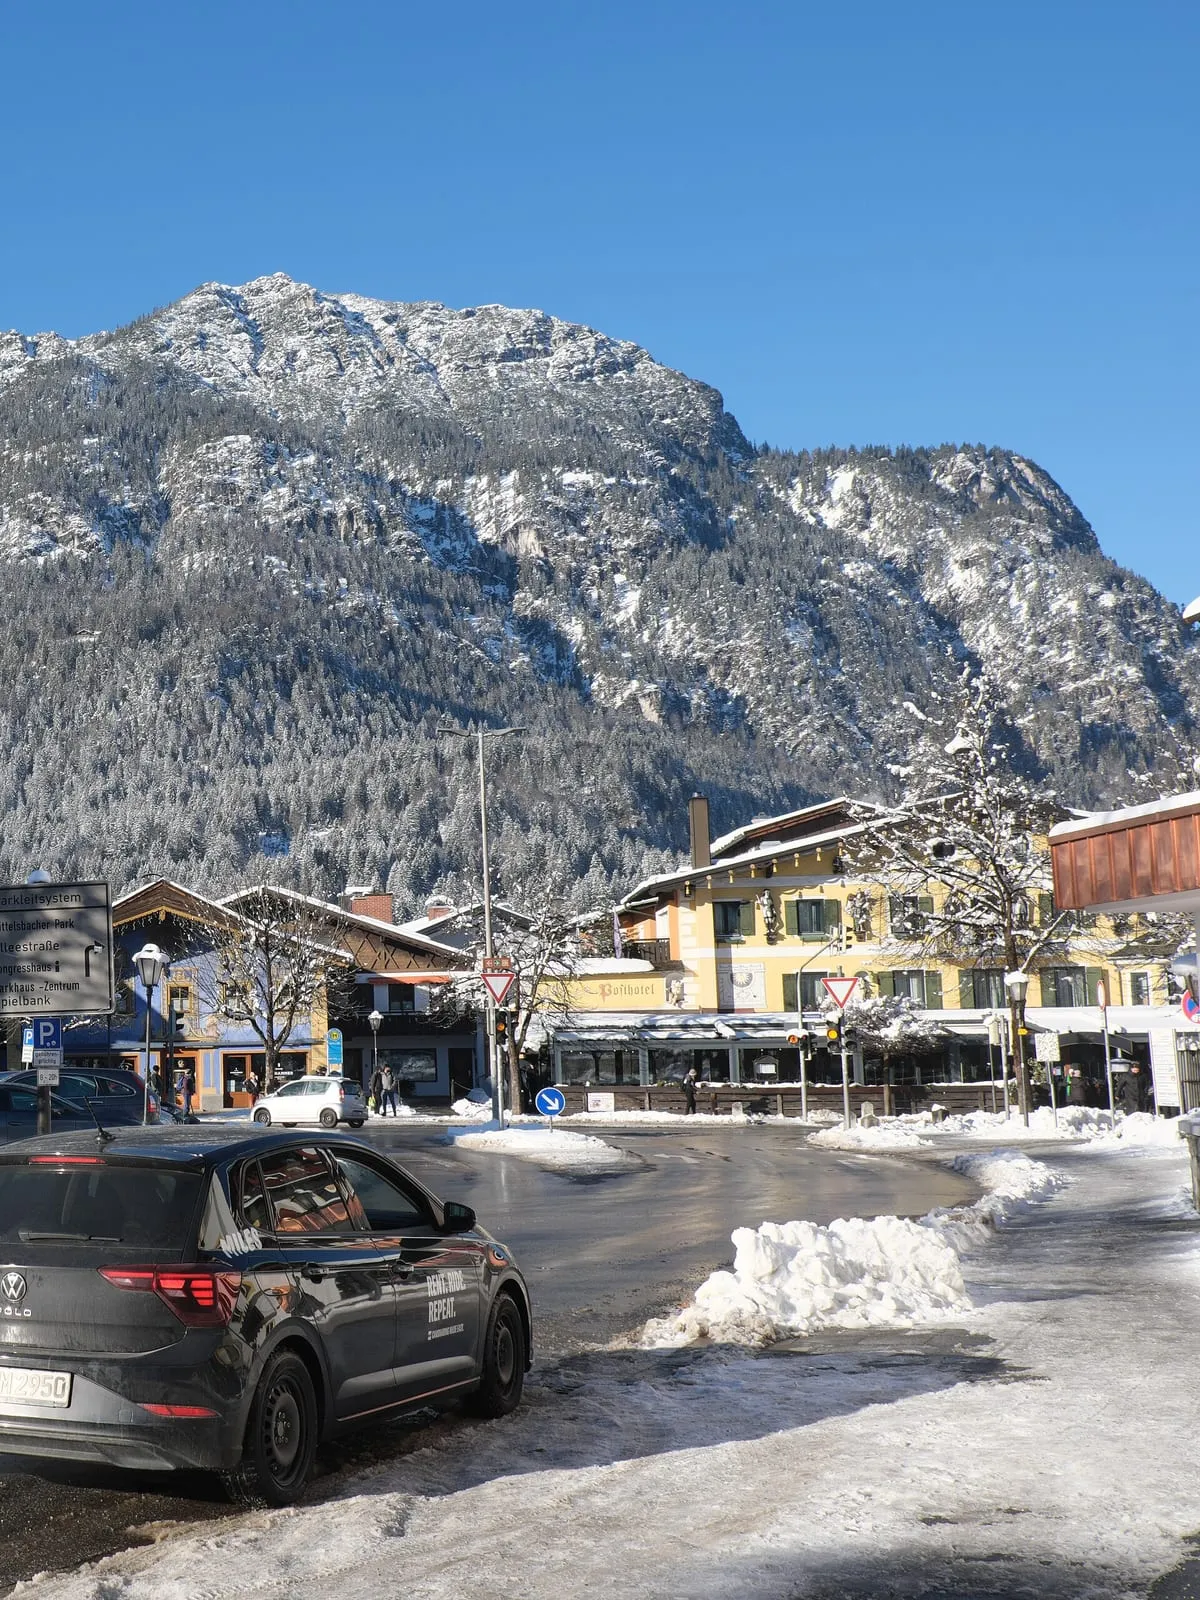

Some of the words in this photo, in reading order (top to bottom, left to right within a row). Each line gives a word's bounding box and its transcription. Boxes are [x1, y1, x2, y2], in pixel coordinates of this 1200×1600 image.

[54, 918, 75, 929] Park
[220, 1227, 263, 1259] MILES
[428, 1297, 457, 1323] REPEAT.
